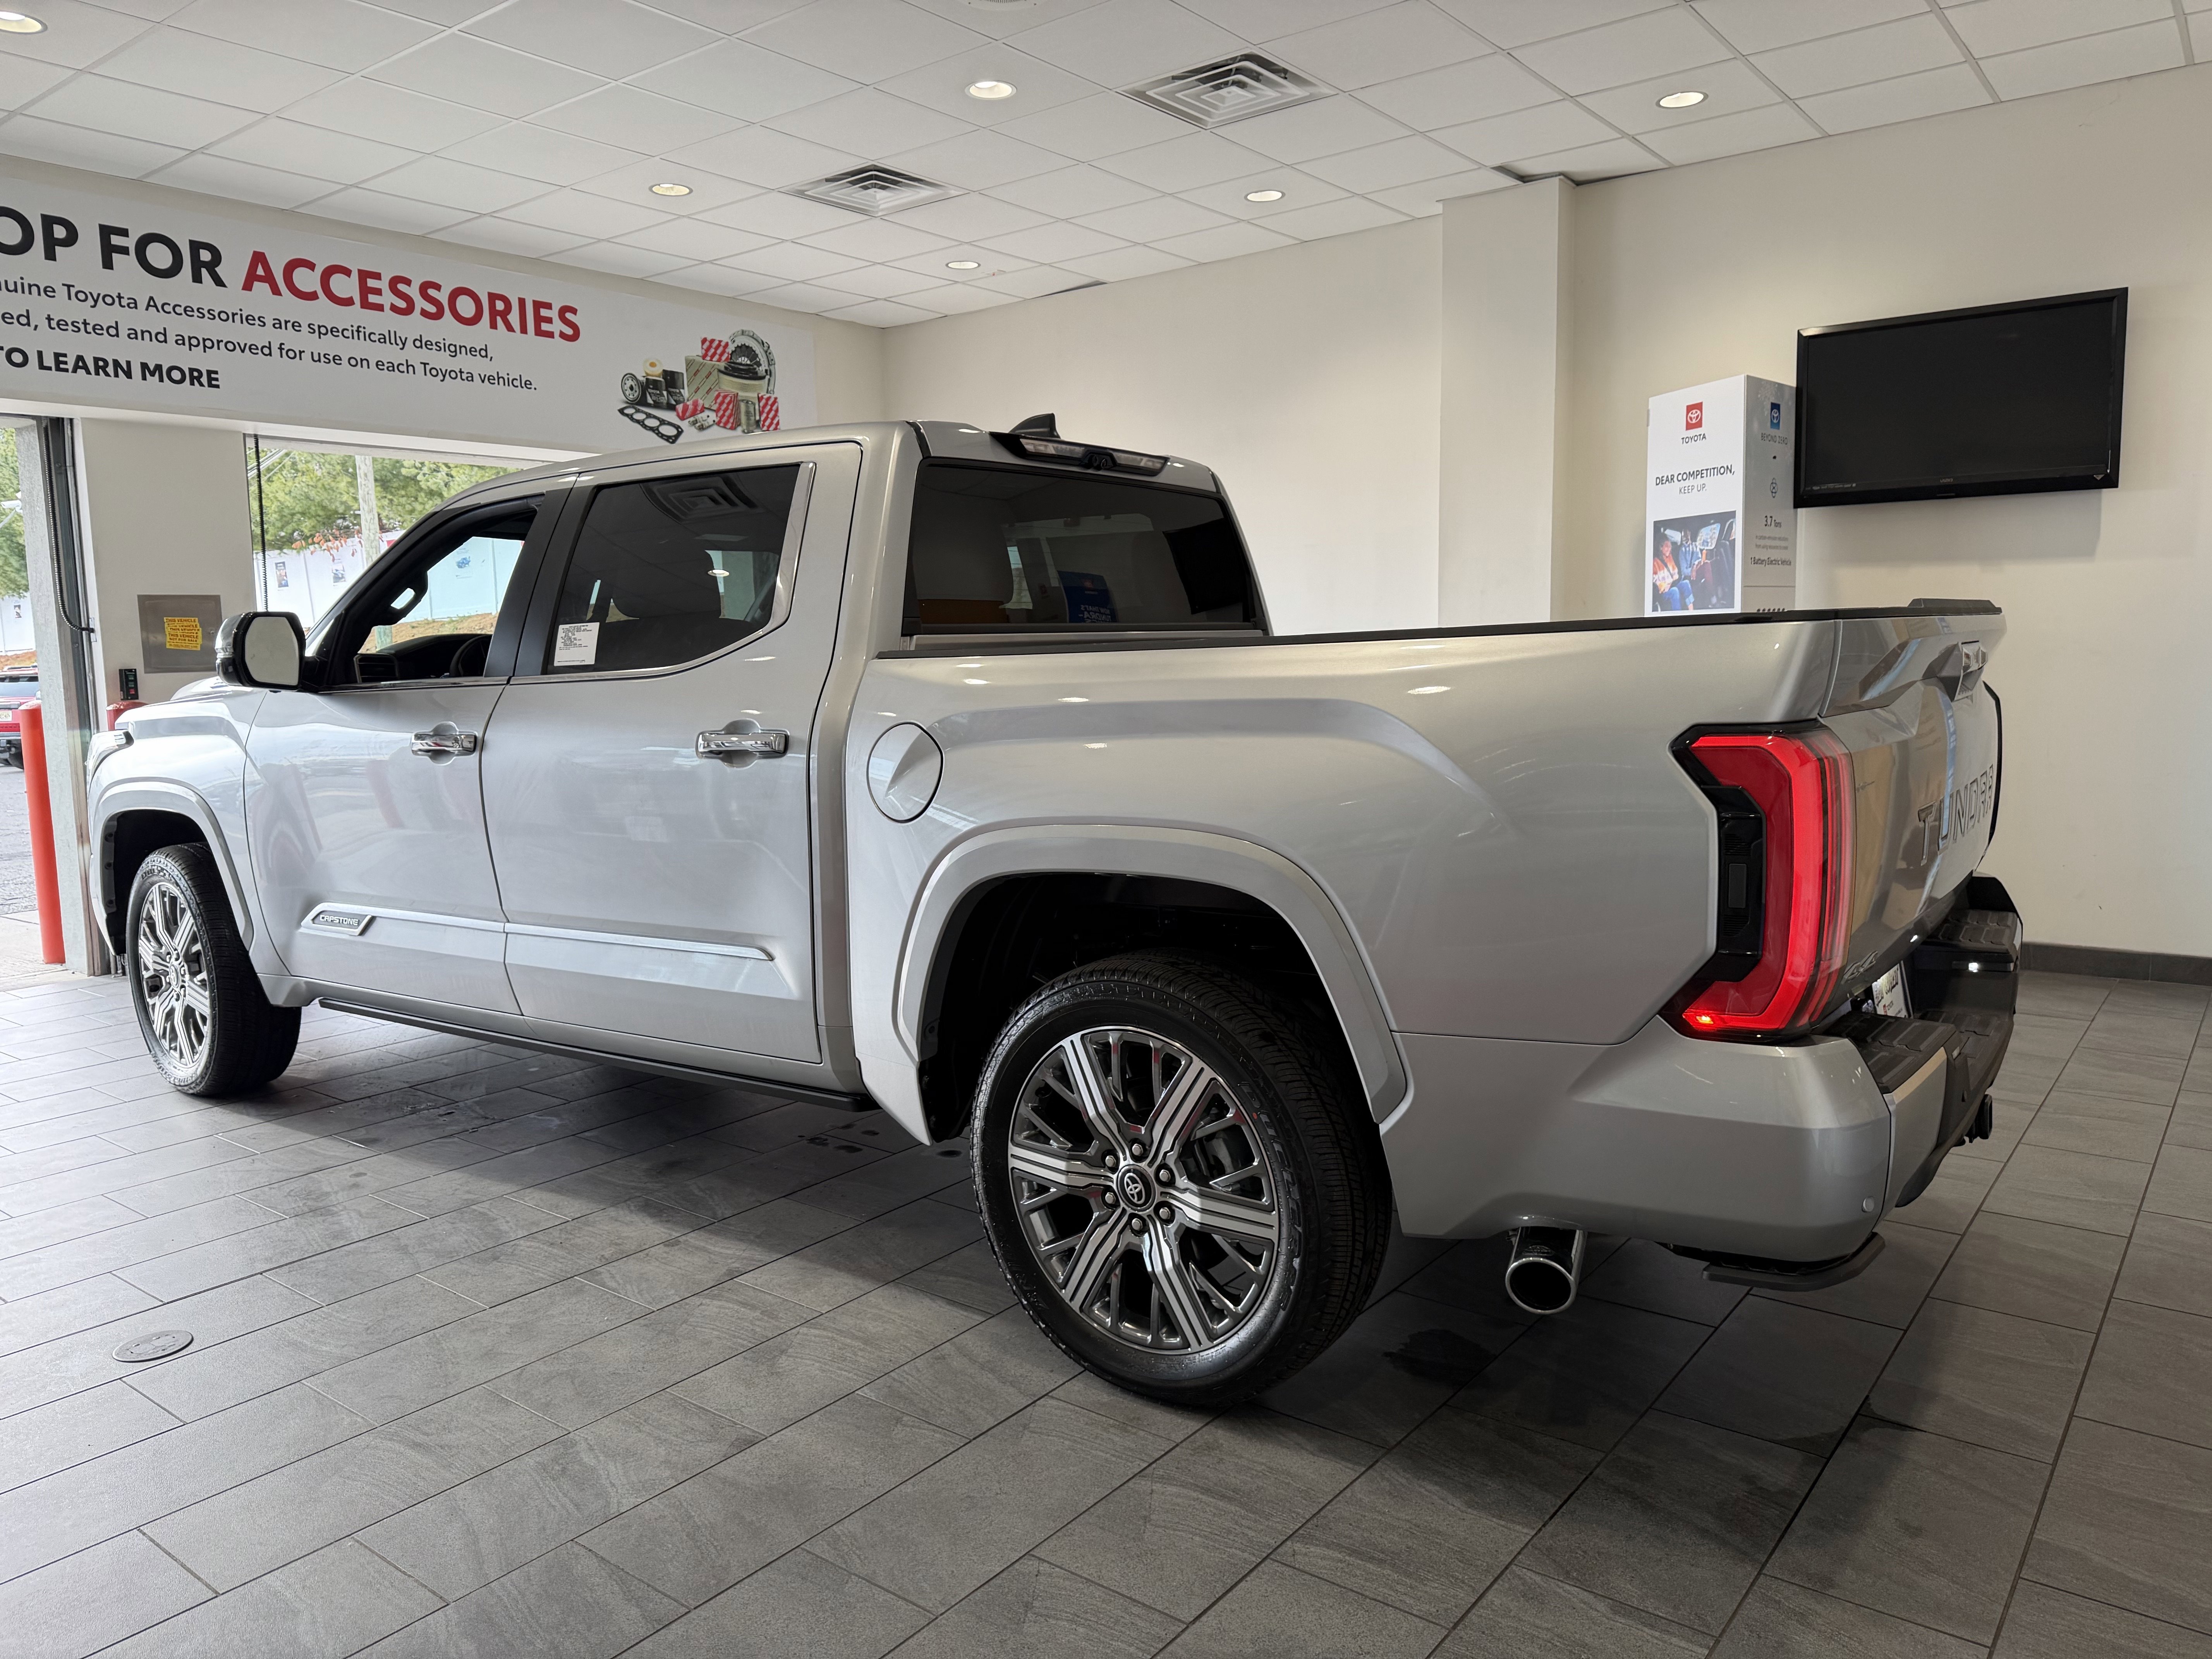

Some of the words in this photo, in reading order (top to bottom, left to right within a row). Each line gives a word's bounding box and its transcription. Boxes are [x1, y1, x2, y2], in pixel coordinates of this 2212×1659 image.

[98, 223, 228, 289] FOR
[241, 250, 580, 342] ACCESSORIES
[62, 283, 138, 310] Toyota
[144, 295, 266, 328] Accessories
[272, 318, 302, 333] are
[307, 323, 408, 351] specifically
[412, 334, 493, 362] designed,
[45, 314, 120, 338] tested
[127, 327, 168, 344] and
[174, 334, 272, 357] approved
[277, 342, 305, 361] for
[311, 351, 342, 366] use
[347, 356, 370, 369] on
[375, 359, 416, 375] each
[419, 362, 474, 382] Toyota
[478, 371, 537, 390] vehicle.
[36, 350, 133, 380] LEARN
[139, 361, 220, 389] MORE
[1681, 433, 1707, 445] TOYOTA
[1656, 474, 1675, 486] DEAR
[1676, 464, 1735, 482] COMPETITION,
[1679, 485, 1695, 495] KEEP
[1697, 483, 1707, 492] UP.
[1764, 515, 1773, 527] 3.7
[1918, 764, 1994, 867] TUNDRA
[319, 914, 359, 926] CAPSTONE
